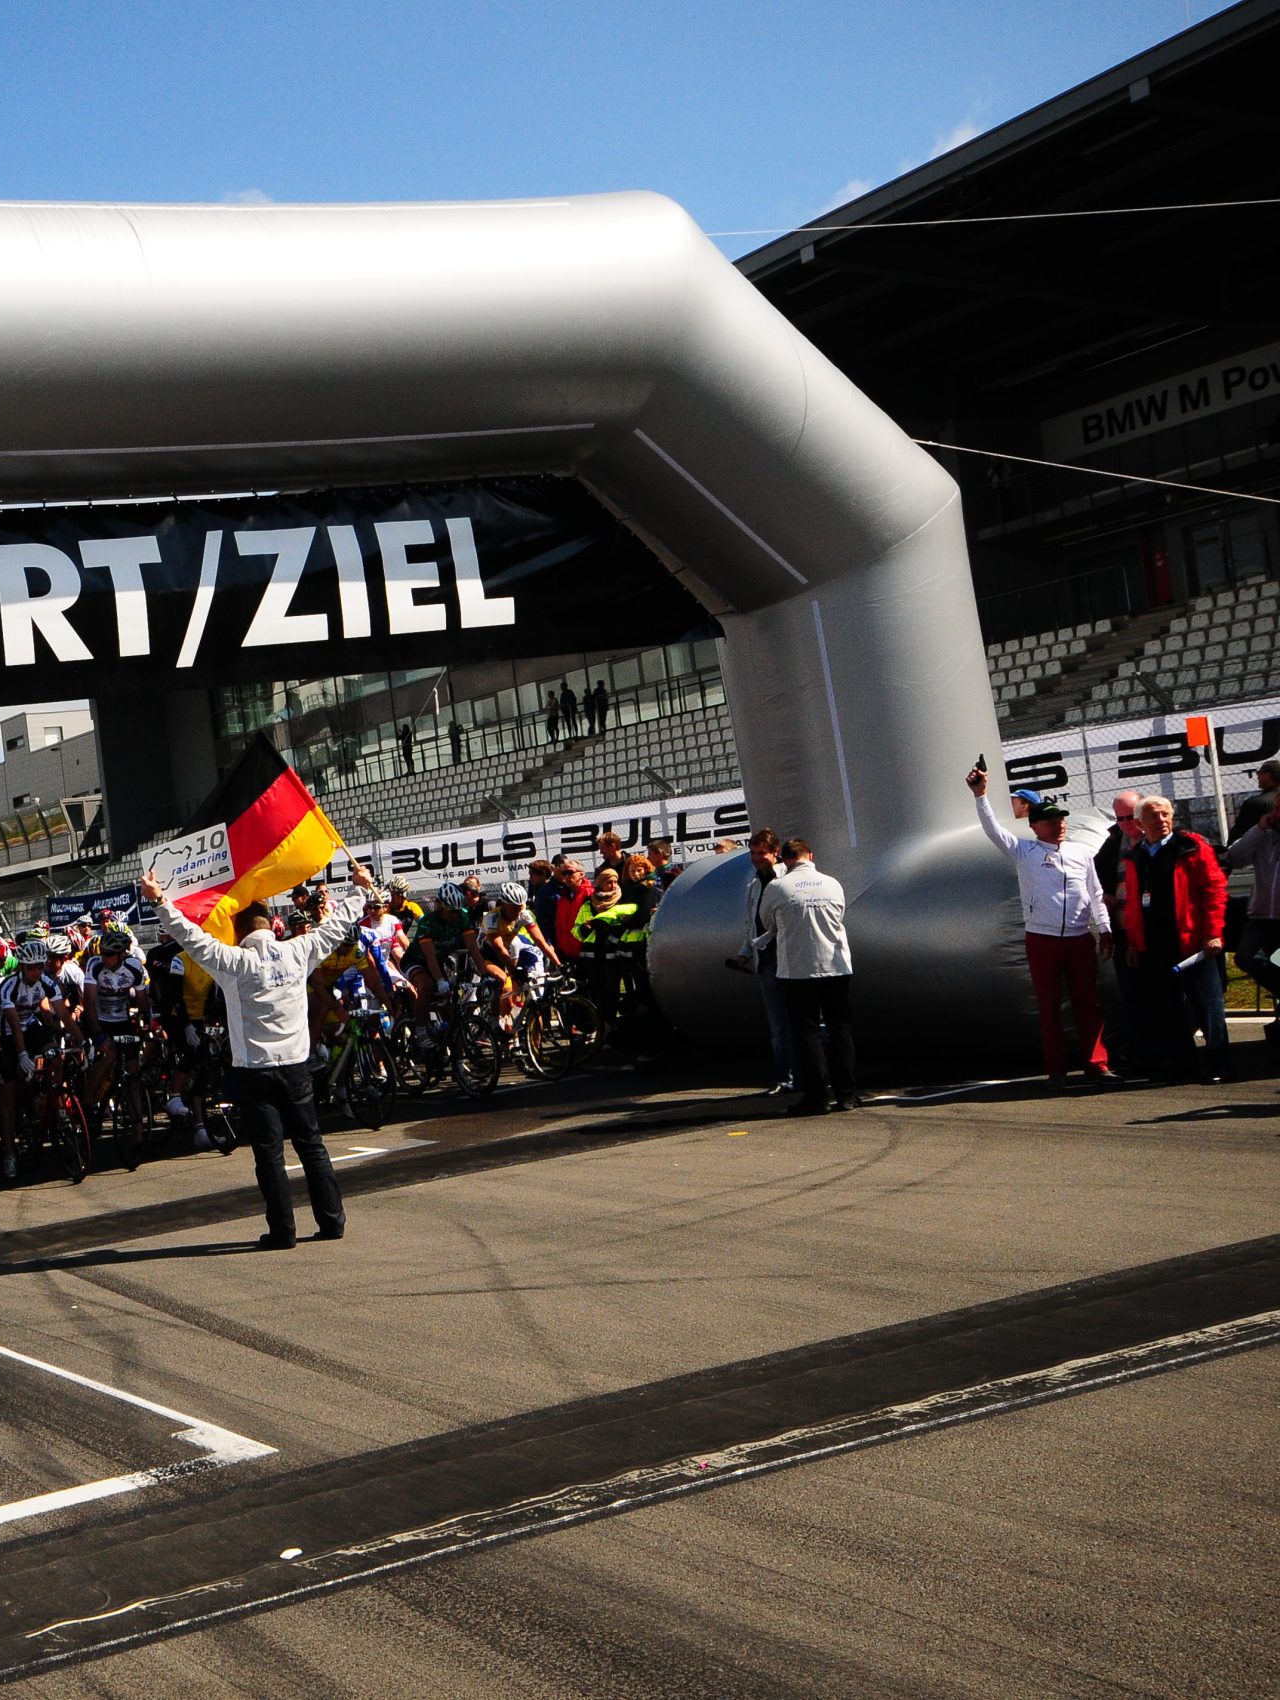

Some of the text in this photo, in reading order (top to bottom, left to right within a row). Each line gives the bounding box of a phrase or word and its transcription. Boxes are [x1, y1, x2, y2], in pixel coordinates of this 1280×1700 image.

[1081, 389, 1169, 446] BMW
[1178, 376, 1211, 415] M
[195, 829, 225, 856] 10
[560, 802, 752, 855] BULLS
[391, 831, 537, 875] BULLS
[177, 865, 231, 889] BULLS
[436, 863, 531, 880] THE RIDE YOU WAN
